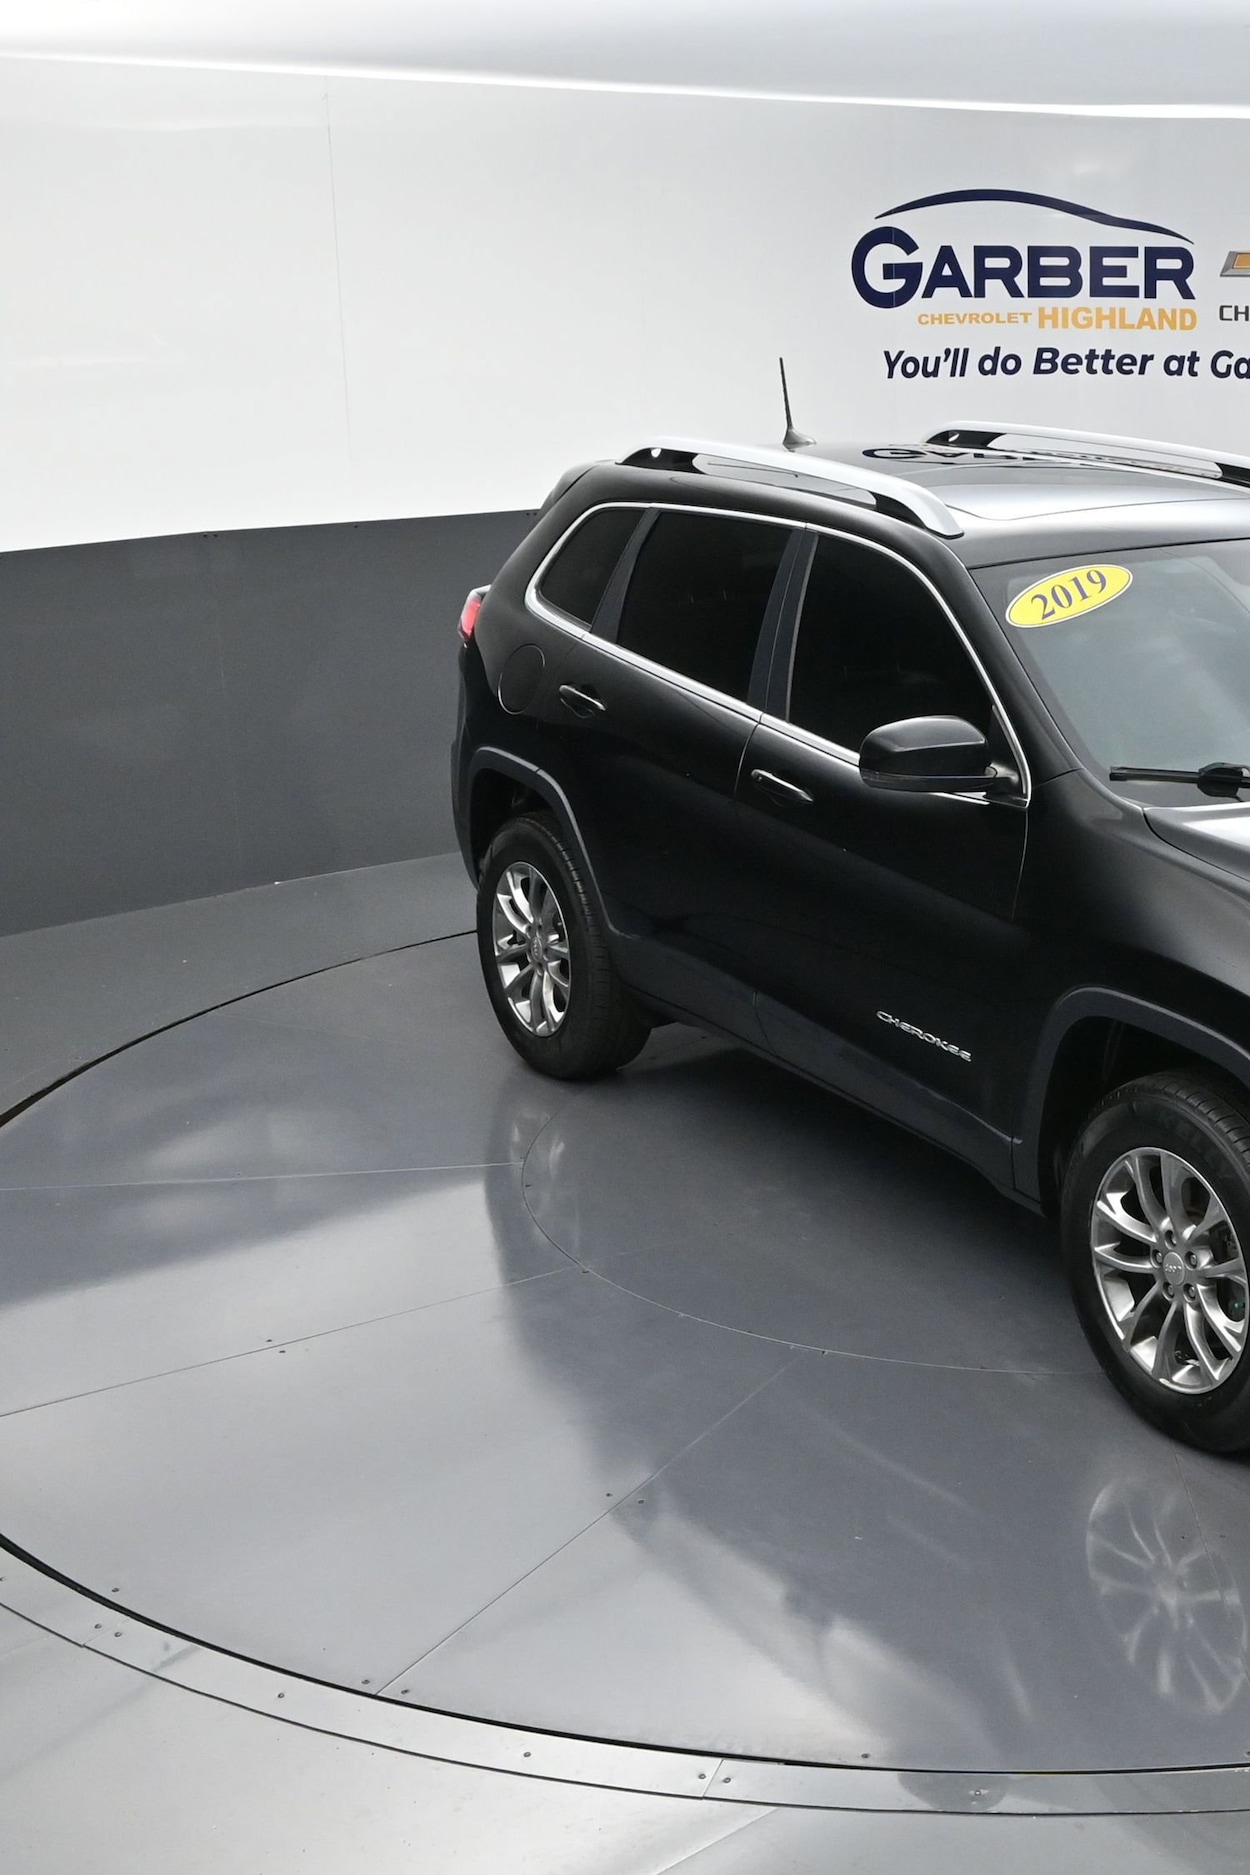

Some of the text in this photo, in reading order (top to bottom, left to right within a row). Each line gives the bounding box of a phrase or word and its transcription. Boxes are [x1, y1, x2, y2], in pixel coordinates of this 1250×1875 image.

[851, 226, 1196, 309] GARBER
[917, 306, 1198, 332] CHEVROLET HIGHLAND
[977, 346, 1022, 377] do
[1032, 347, 1155, 376] Better
[1163, 350, 1200, 378] at
[1030, 569, 1107, 620] 2019
[876, 1010, 972, 1062] CHEROKEE
